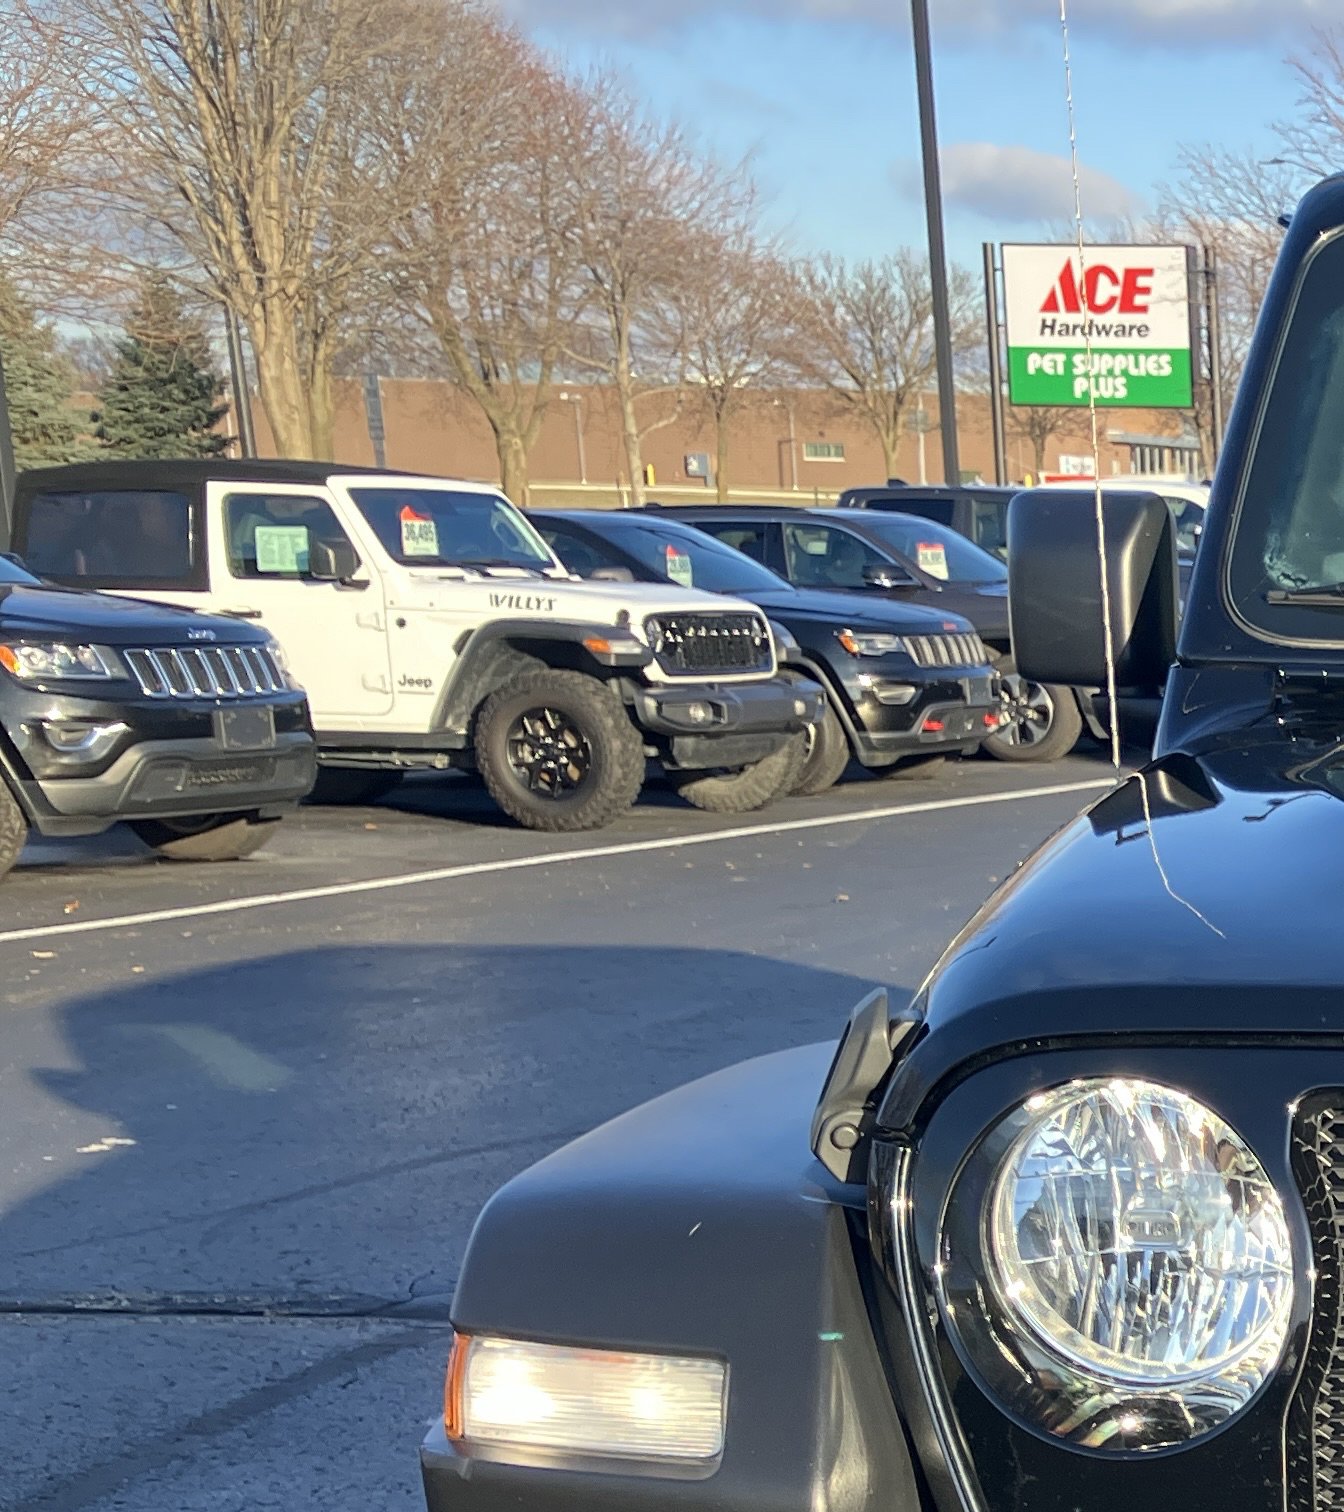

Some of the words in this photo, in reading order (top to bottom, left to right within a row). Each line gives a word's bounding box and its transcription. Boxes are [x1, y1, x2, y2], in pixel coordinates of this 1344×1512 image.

[1039, 256, 1155, 315] ACE
[1039, 318, 1150, 338] Hardware
[1027, 353, 1066, 376] PET
[1073, 354, 1172, 377] SUPPLIES
[1073, 377, 1127, 398] PLUS
[489, 593, 557, 611] WILLYS
[398, 675, 432, 688] Jeep
